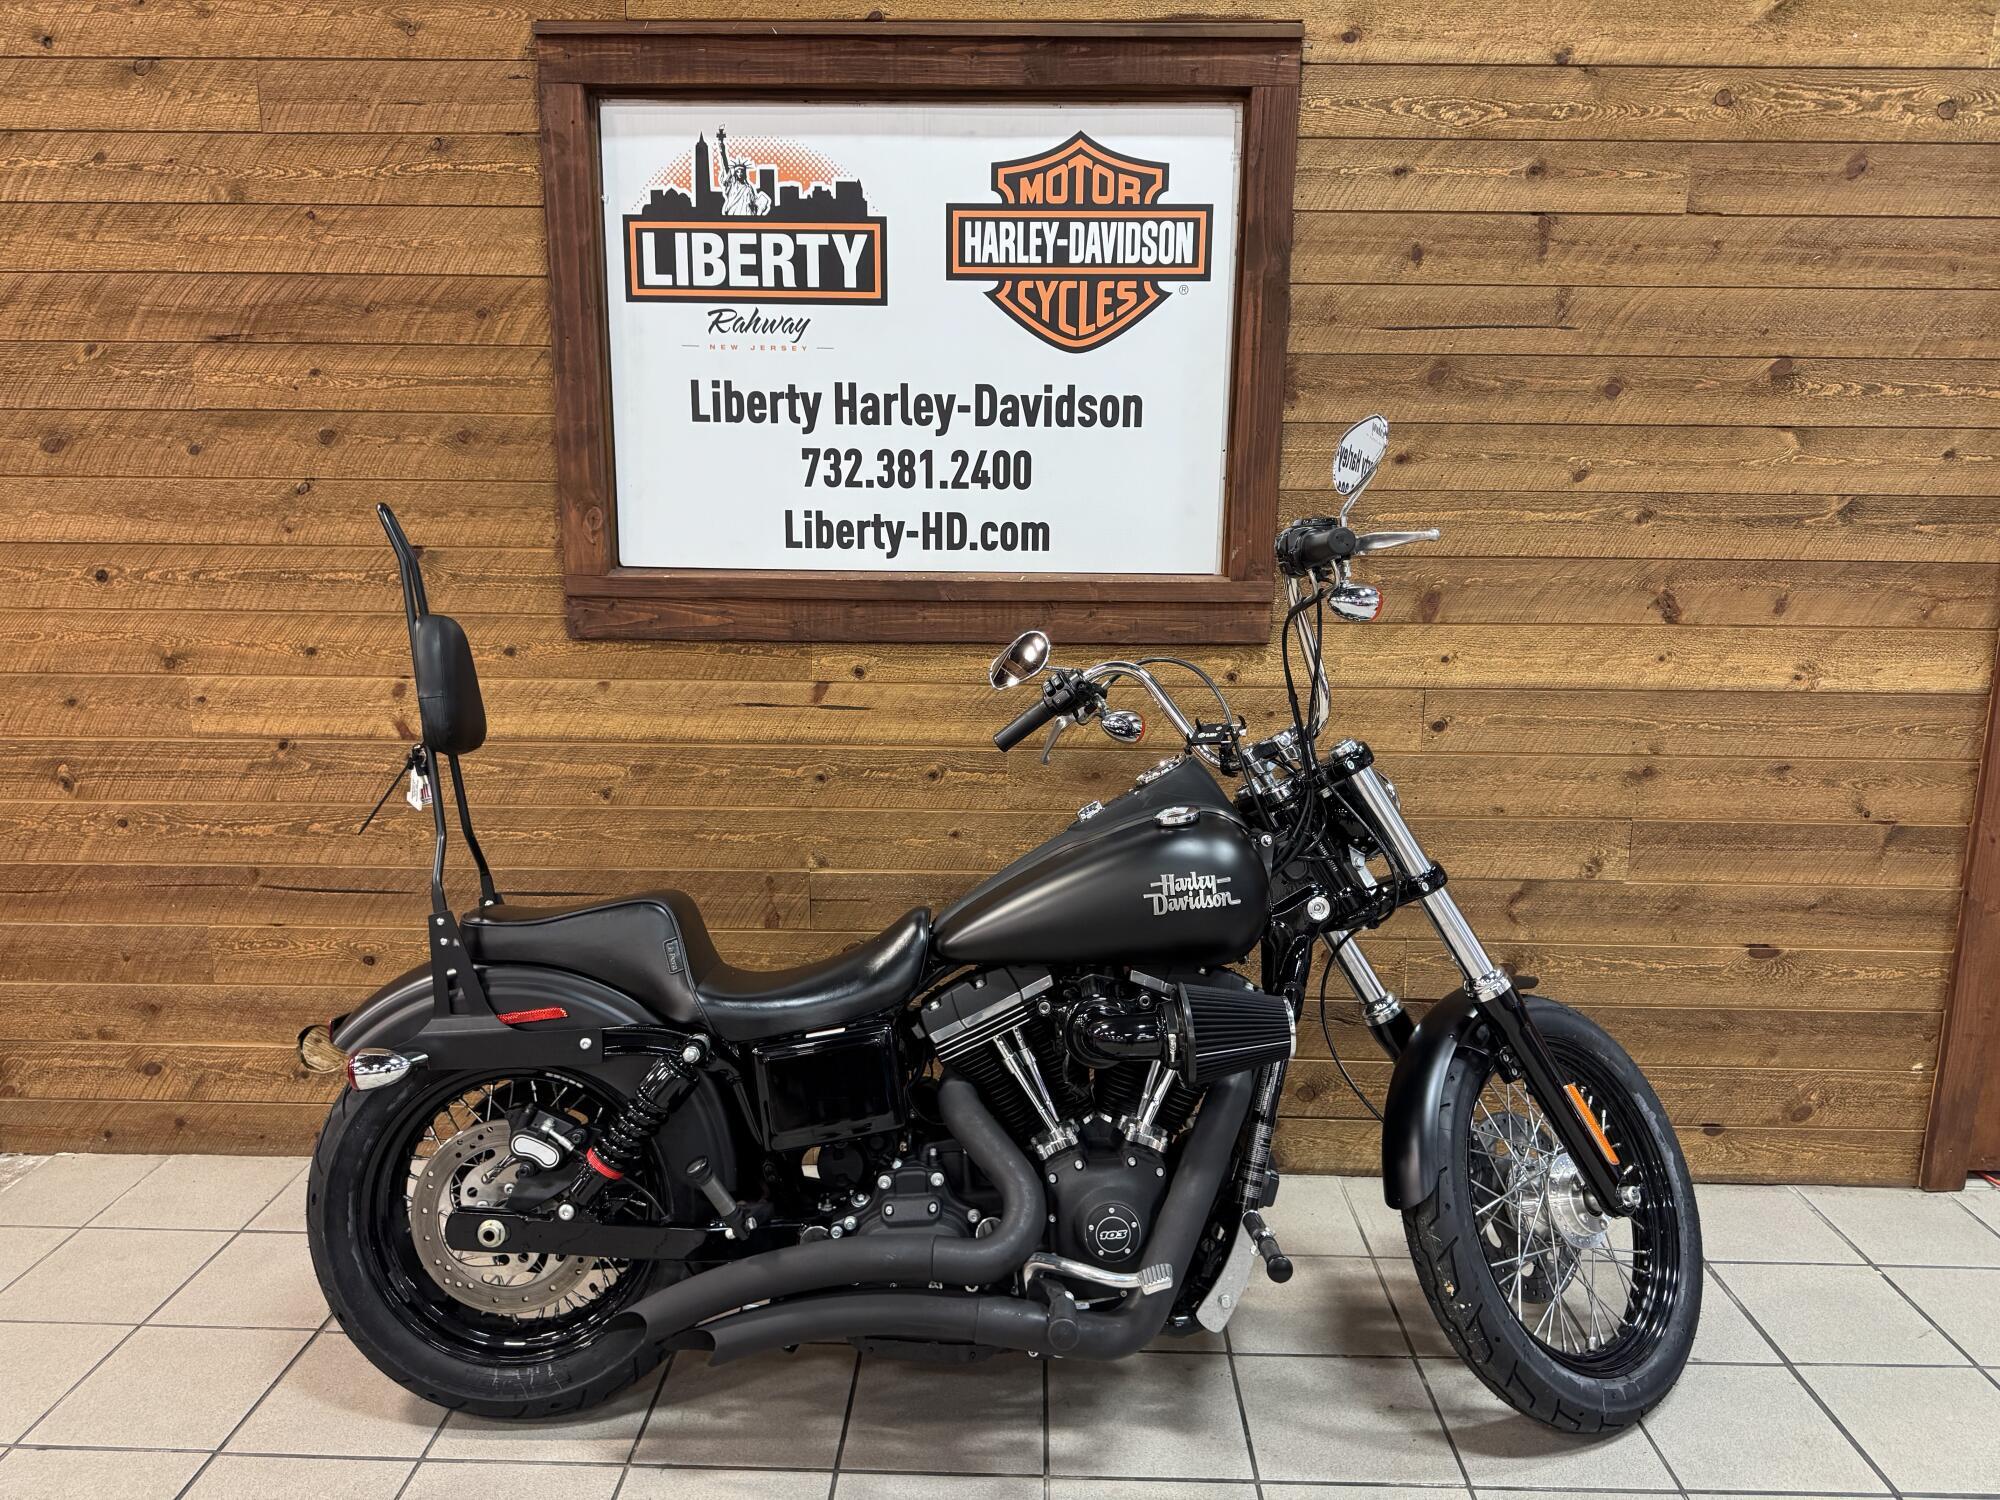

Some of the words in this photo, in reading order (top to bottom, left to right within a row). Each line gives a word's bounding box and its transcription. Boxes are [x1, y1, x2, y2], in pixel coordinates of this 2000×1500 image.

[1019, 153, 1141, 205] MOTOR
[641, 231, 868, 289] LIBERTY
[964, 220, 1195, 265] HARLEY-DAVIDSON
[707, 306, 812, 343] Rahway
[1017, 280, 1138, 337] CYCLES
[709, 343, 738, 351] NEW
[750, 344, 808, 352] JERSEY
[690, 379, 823, 435] Liberty
[834, 381, 1143, 437] Harley-Davidson
[801, 447, 1032, 490] 732.381.2400
[784, 509, 1051, 559] Liberty-HD.com
[1145, 890, 1240, 916] Davidson
[1153, 871, 1225, 896] Harley
[1099, 1229, 1128, 1240] 103
